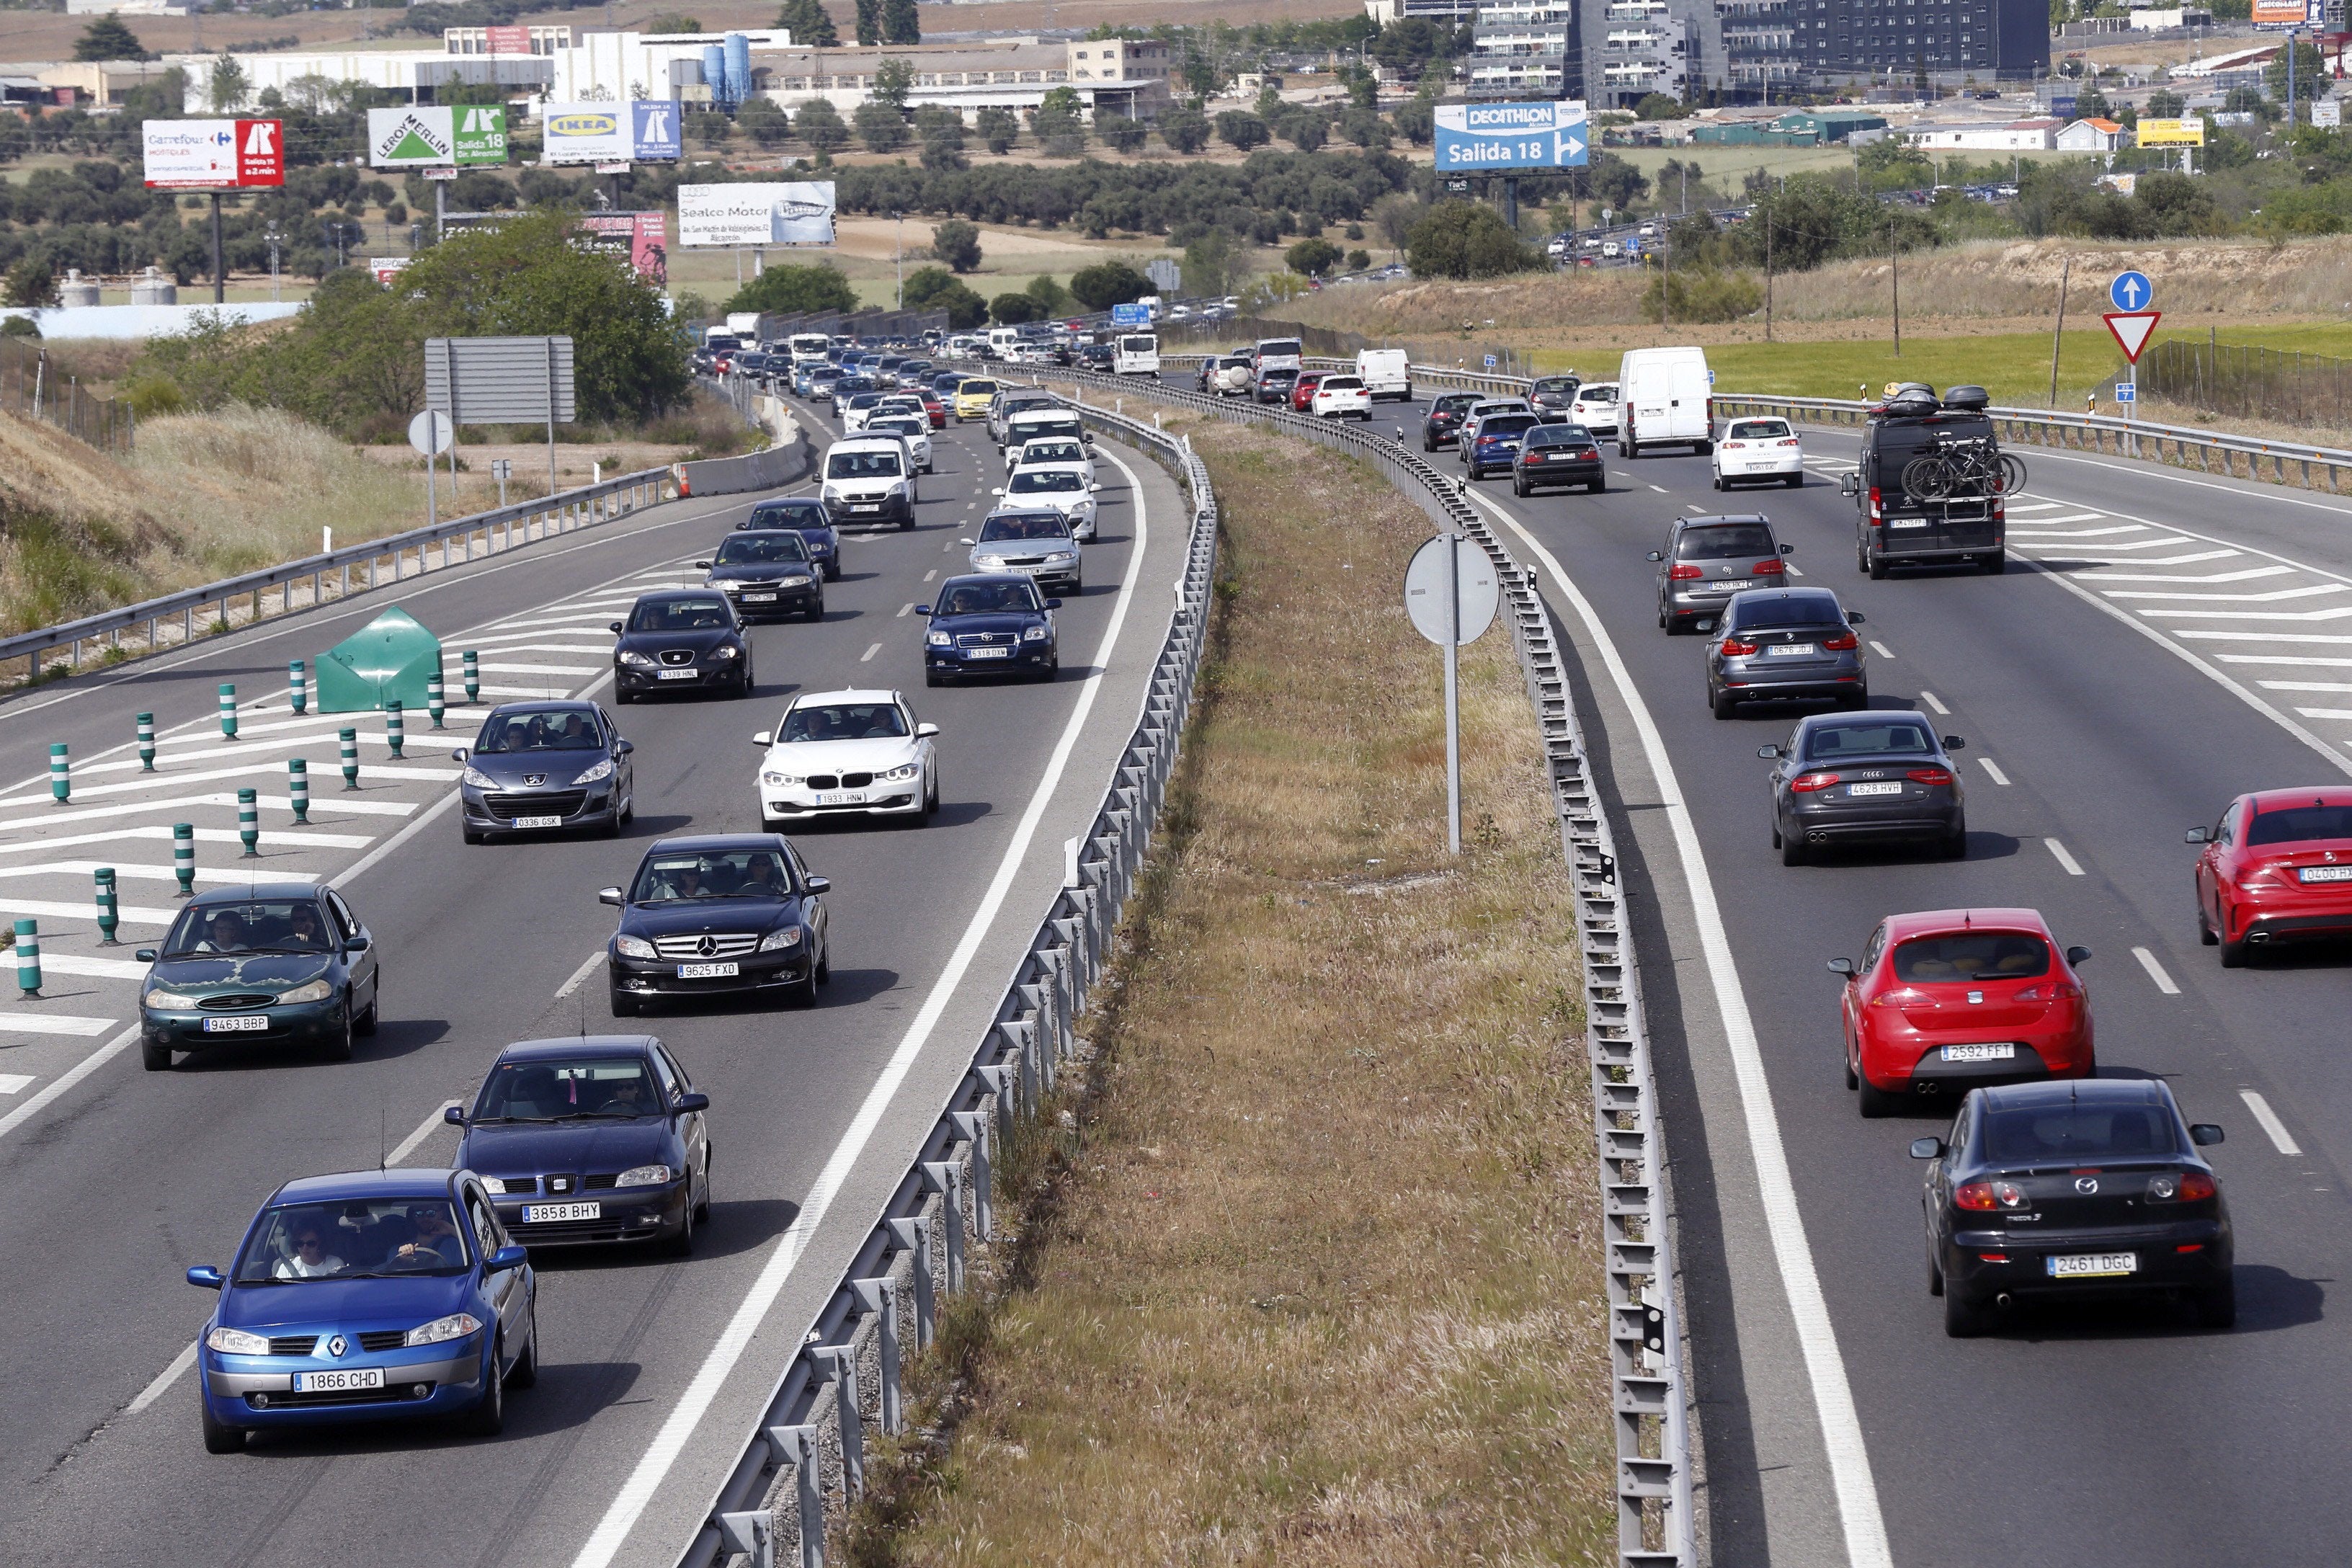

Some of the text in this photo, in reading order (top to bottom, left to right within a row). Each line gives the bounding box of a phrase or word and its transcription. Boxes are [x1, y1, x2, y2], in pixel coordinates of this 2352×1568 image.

[1469, 108, 1552, 125] DECATHLON
[558, 120, 609, 130] IKEA
[148, 133, 204, 145] Carrefour
[377, 122, 409, 158] LEROY
[405, 114, 450, 155] MERLIN
[456, 133, 504, 150] Salida 18
[1448, 142, 1542, 163] Salida 18
[680, 207, 768, 218] Sealco Motor
[1854, 783, 1899, 793] 4628 HVH
[823, 793, 863, 803] 1933 HNM
[519, 816, 558, 827] 0336 GSK
[2307, 868, 2335, 880] 0400
[685, 963, 735, 976] 9625 FXD
[211, 1018, 240, 1030] 9463
[244, 1017, 264, 1029] BBP
[1952, 1044, 2010, 1059] 2592 FFT
[531, 1206, 567, 1220] 3858
[572, 1204, 597, 1218] BHY
[2059, 1255, 2132, 1272] 2461 DGC
[310, 1373, 345, 1389] 1866
[350, 1371, 378, 1387] CHD
